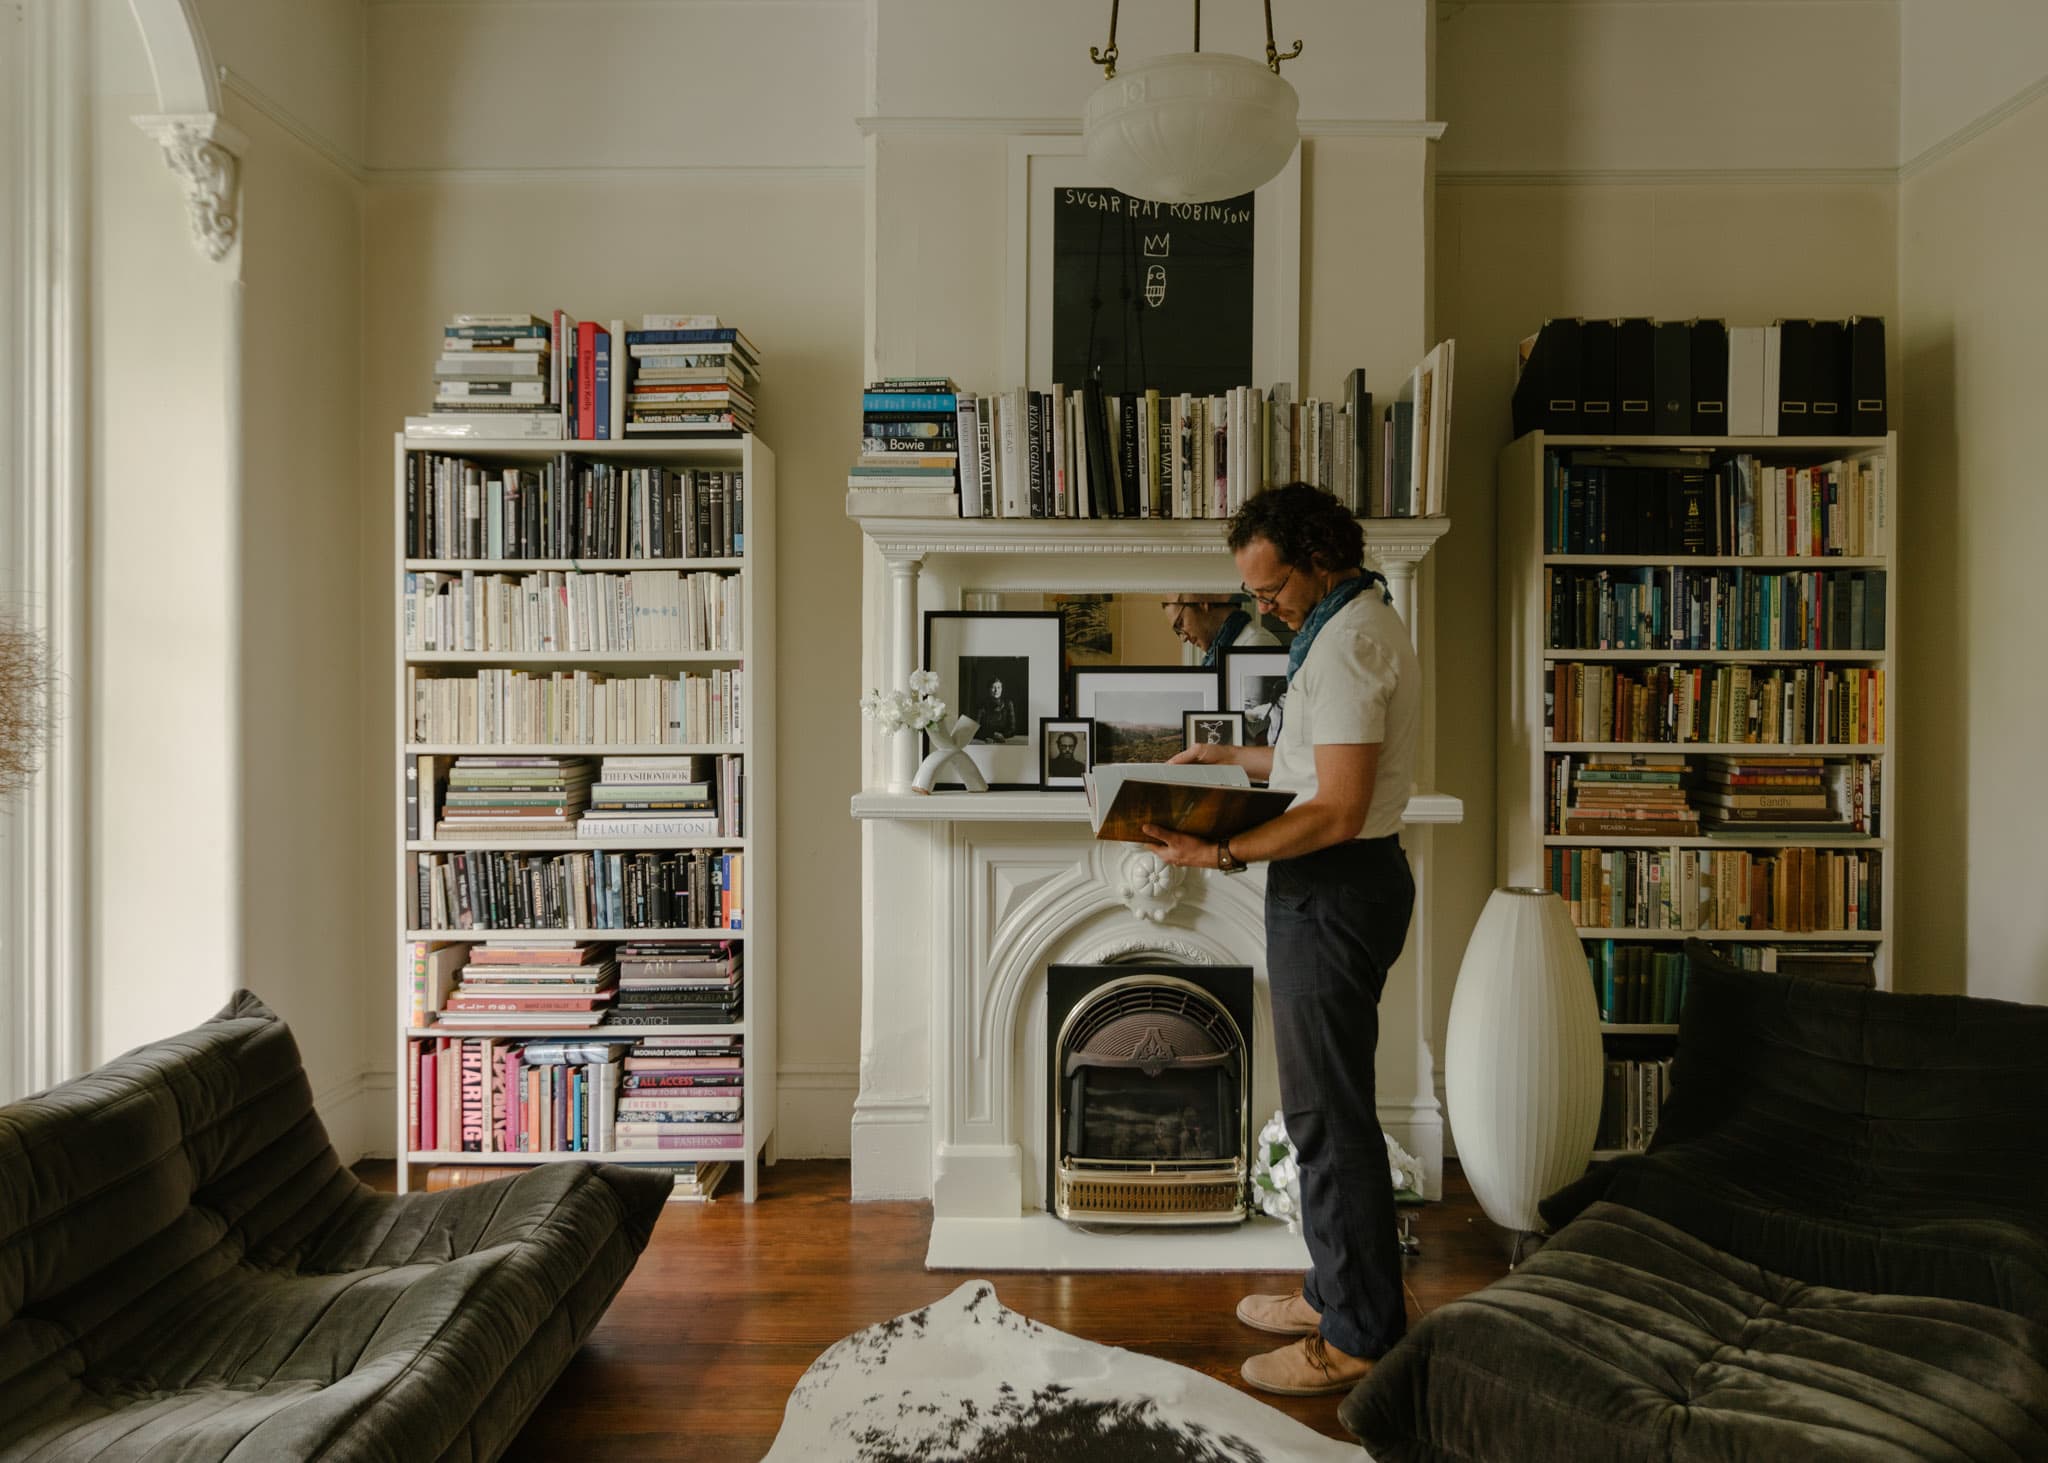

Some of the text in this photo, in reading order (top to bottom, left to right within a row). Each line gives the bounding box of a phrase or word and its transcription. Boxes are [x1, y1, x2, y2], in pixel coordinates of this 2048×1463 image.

[1129, 199, 1160, 219] RAY
[1170, 202, 1251, 224] ROBINSON
[889, 438, 925, 451] Bowie
[1029, 404, 1040, 493] RYAN MCGINLEY
[1125, 406, 1136, 480] Calder Jewelry
[980, 450, 992, 486] WALL
[1161, 451, 1172, 487] WALL
[581, 823, 704, 834] HELMUT NEWTON
[462, 1052, 482, 1141] HARING
[640, 1076, 694, 1087] ALL ACCESS
